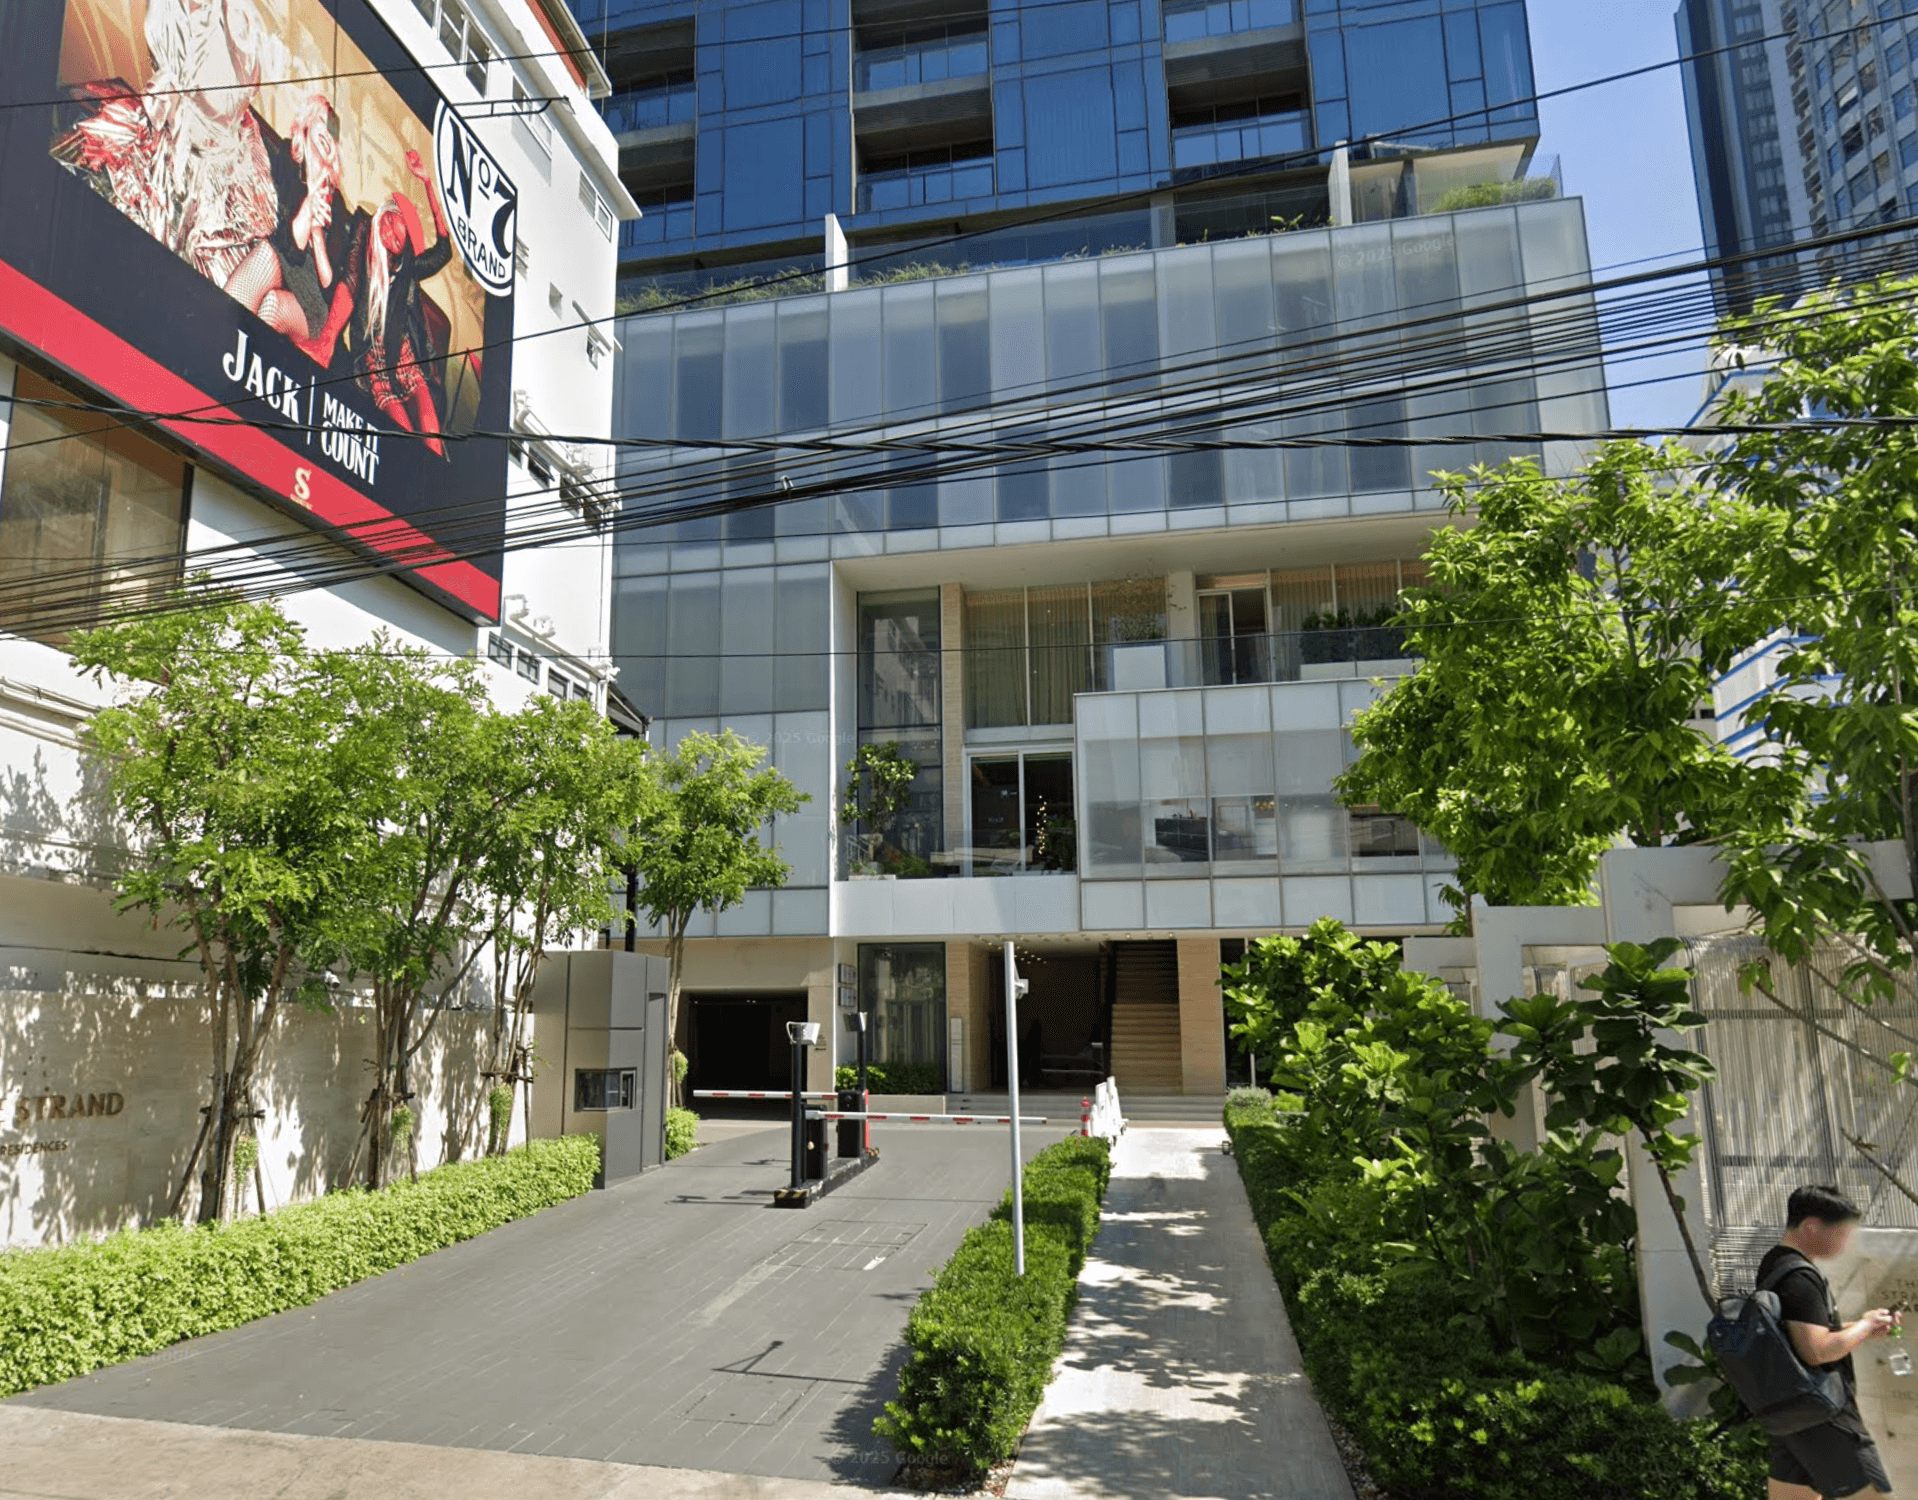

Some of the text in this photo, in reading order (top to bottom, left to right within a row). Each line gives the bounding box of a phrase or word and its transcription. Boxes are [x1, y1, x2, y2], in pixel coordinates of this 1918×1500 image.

[457, 216, 506, 279] BRAND
[222, 329, 302, 425] JACK
[321, 420, 380, 486] COUNT
[322, 392, 380, 454] MAKE IT
[14, 1092, 125, 1125] STRAND
[1894, 1279, 1918, 1289] TH
